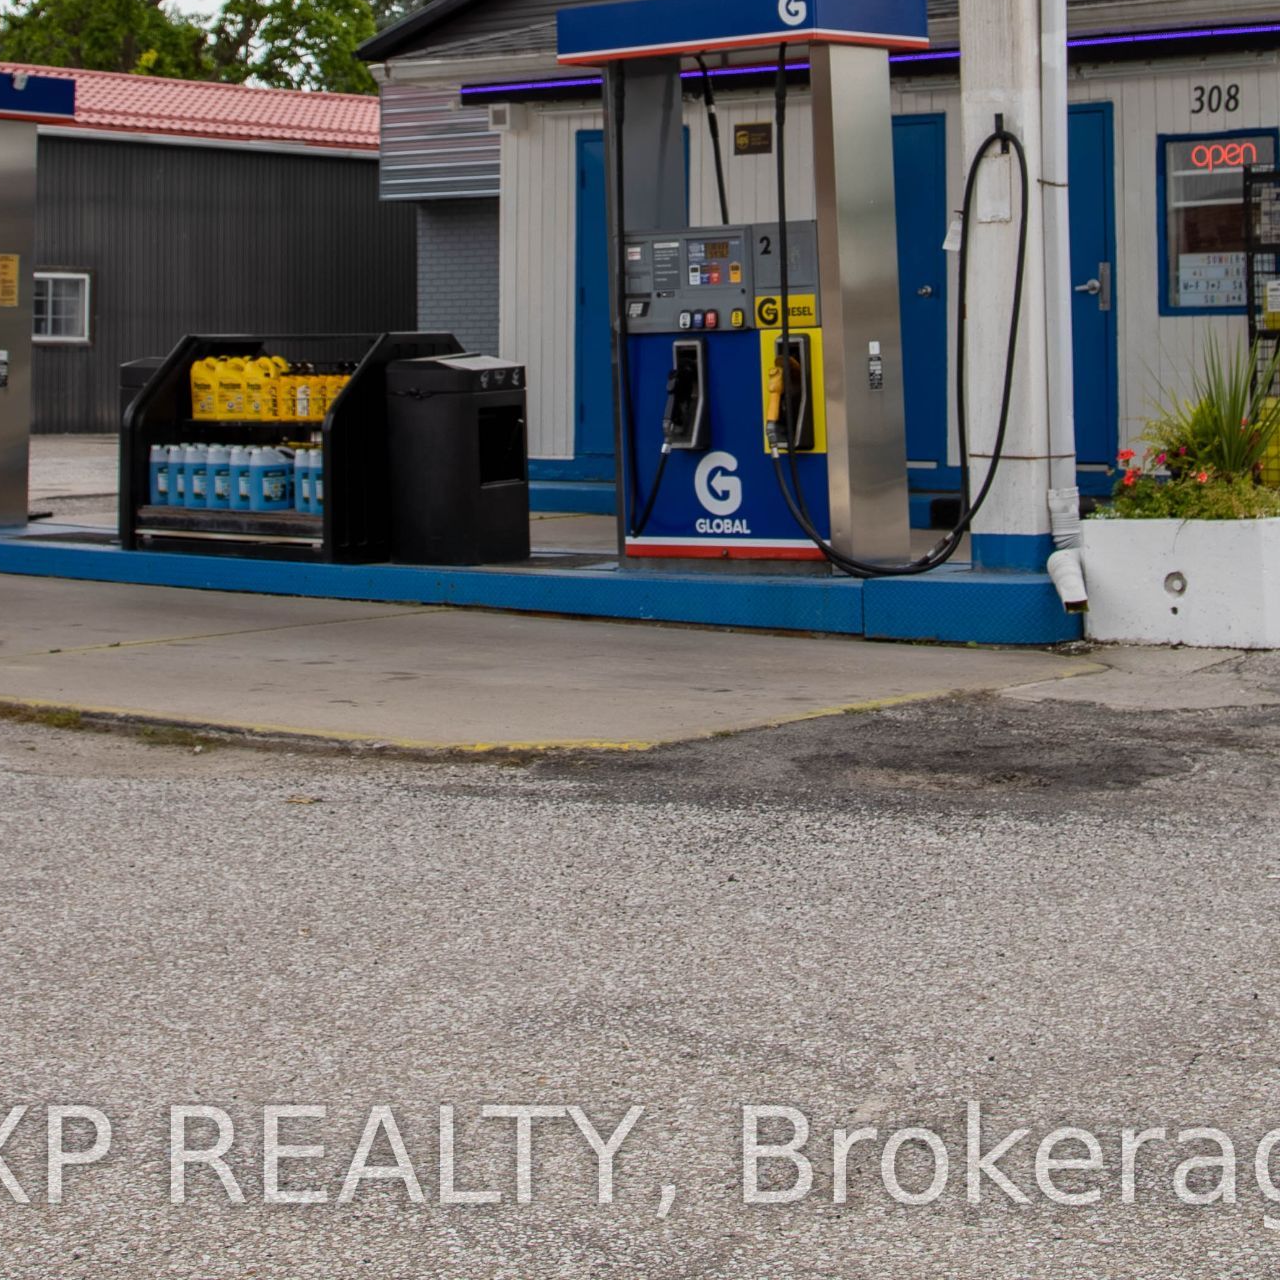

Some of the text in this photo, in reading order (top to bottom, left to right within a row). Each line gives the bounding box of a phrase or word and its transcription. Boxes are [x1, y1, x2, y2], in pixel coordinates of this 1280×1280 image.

[1191, 84, 1240, 114] 308
[1191, 142, 1257, 172] open
[760, 236, 772, 255] 2
[787, 306, 813, 317] IESEL
[695, 518, 752, 534] GLOBAL
